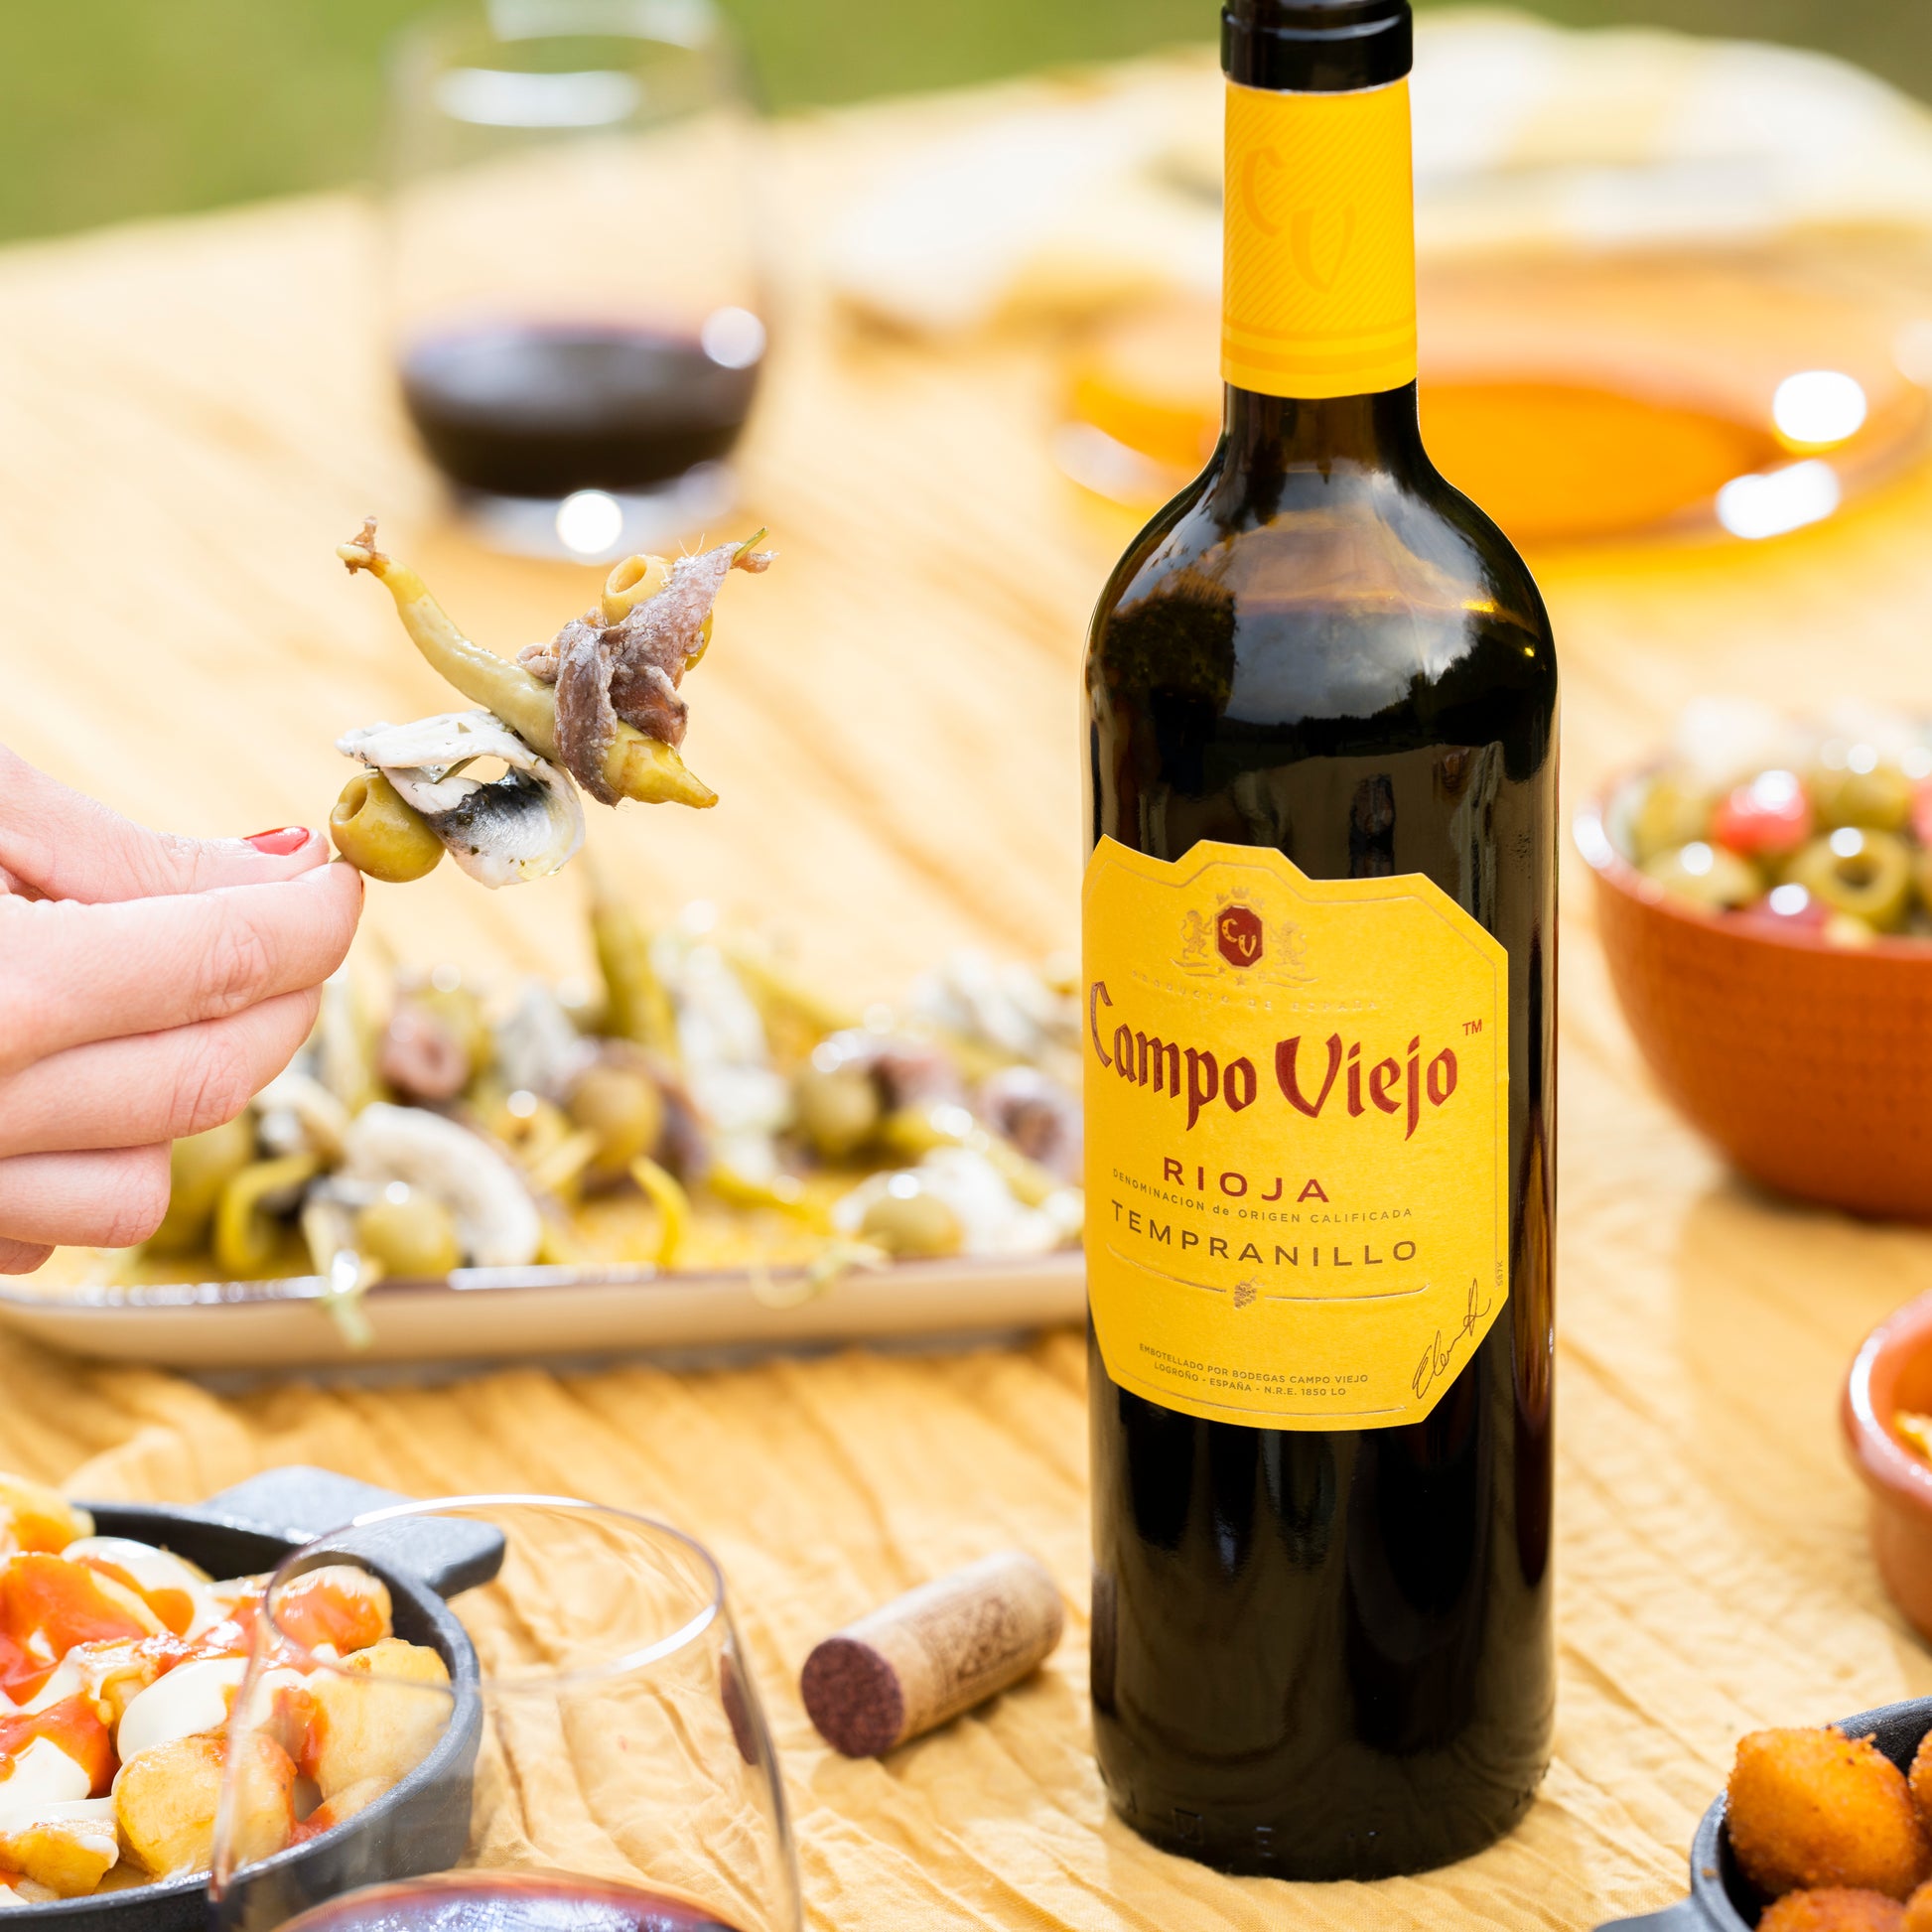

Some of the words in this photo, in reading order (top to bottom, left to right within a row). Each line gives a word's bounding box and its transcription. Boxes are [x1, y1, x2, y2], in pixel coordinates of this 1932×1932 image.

[1090, 981, 1257, 1132] Campo
[1275, 1033, 1458, 1142] Viejo
[1113, 1169, 1204, 1210] DENOMINACION
[1212, 1205, 1230, 1216] de
[1238, 1209, 1301, 1222] ORIGEN
[1310, 1208, 1412, 1223] CALIFICADA
[1164, 1157, 1329, 1203] RIOJA
[1111, 1199, 1417, 1267] TEMPRANILLO
[1139, 1343, 1204, 1371] EMBOTELLADO
[1207, 1365, 1228, 1377] POR
[1232, 1370, 1286, 1383] BODEGAS
[1334, 1374, 1368, 1383] VIEJO
[1154, 1362, 1198, 1382] LOGROÑO
[1209, 1377, 1251, 1392] ESPAÑA
[1264, 1386, 1297, 1396] N.R.E.
